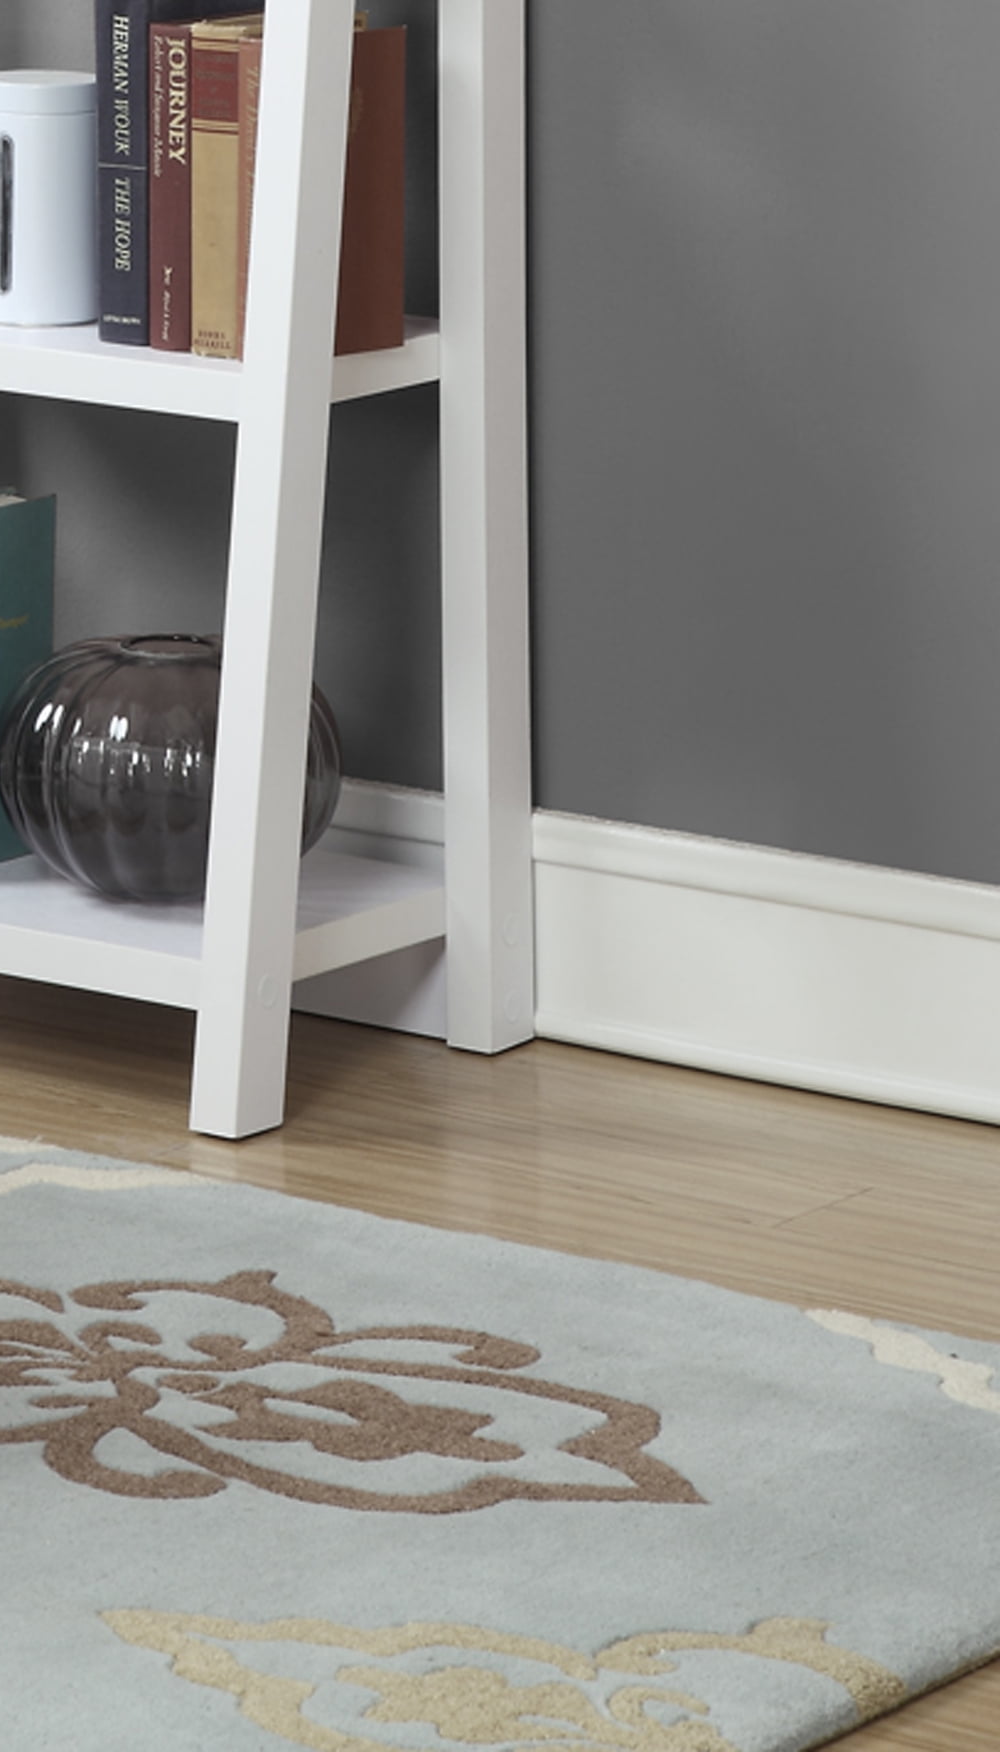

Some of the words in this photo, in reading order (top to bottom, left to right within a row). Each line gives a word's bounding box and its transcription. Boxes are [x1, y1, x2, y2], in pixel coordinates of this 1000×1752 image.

[113, 14, 129, 94] HERMAN
[114, 99, 131, 156] WOUK
[166, 37, 187, 165] JOURNEY
[115, 177, 131, 216] THE
[114, 218, 131, 272] HOPE
